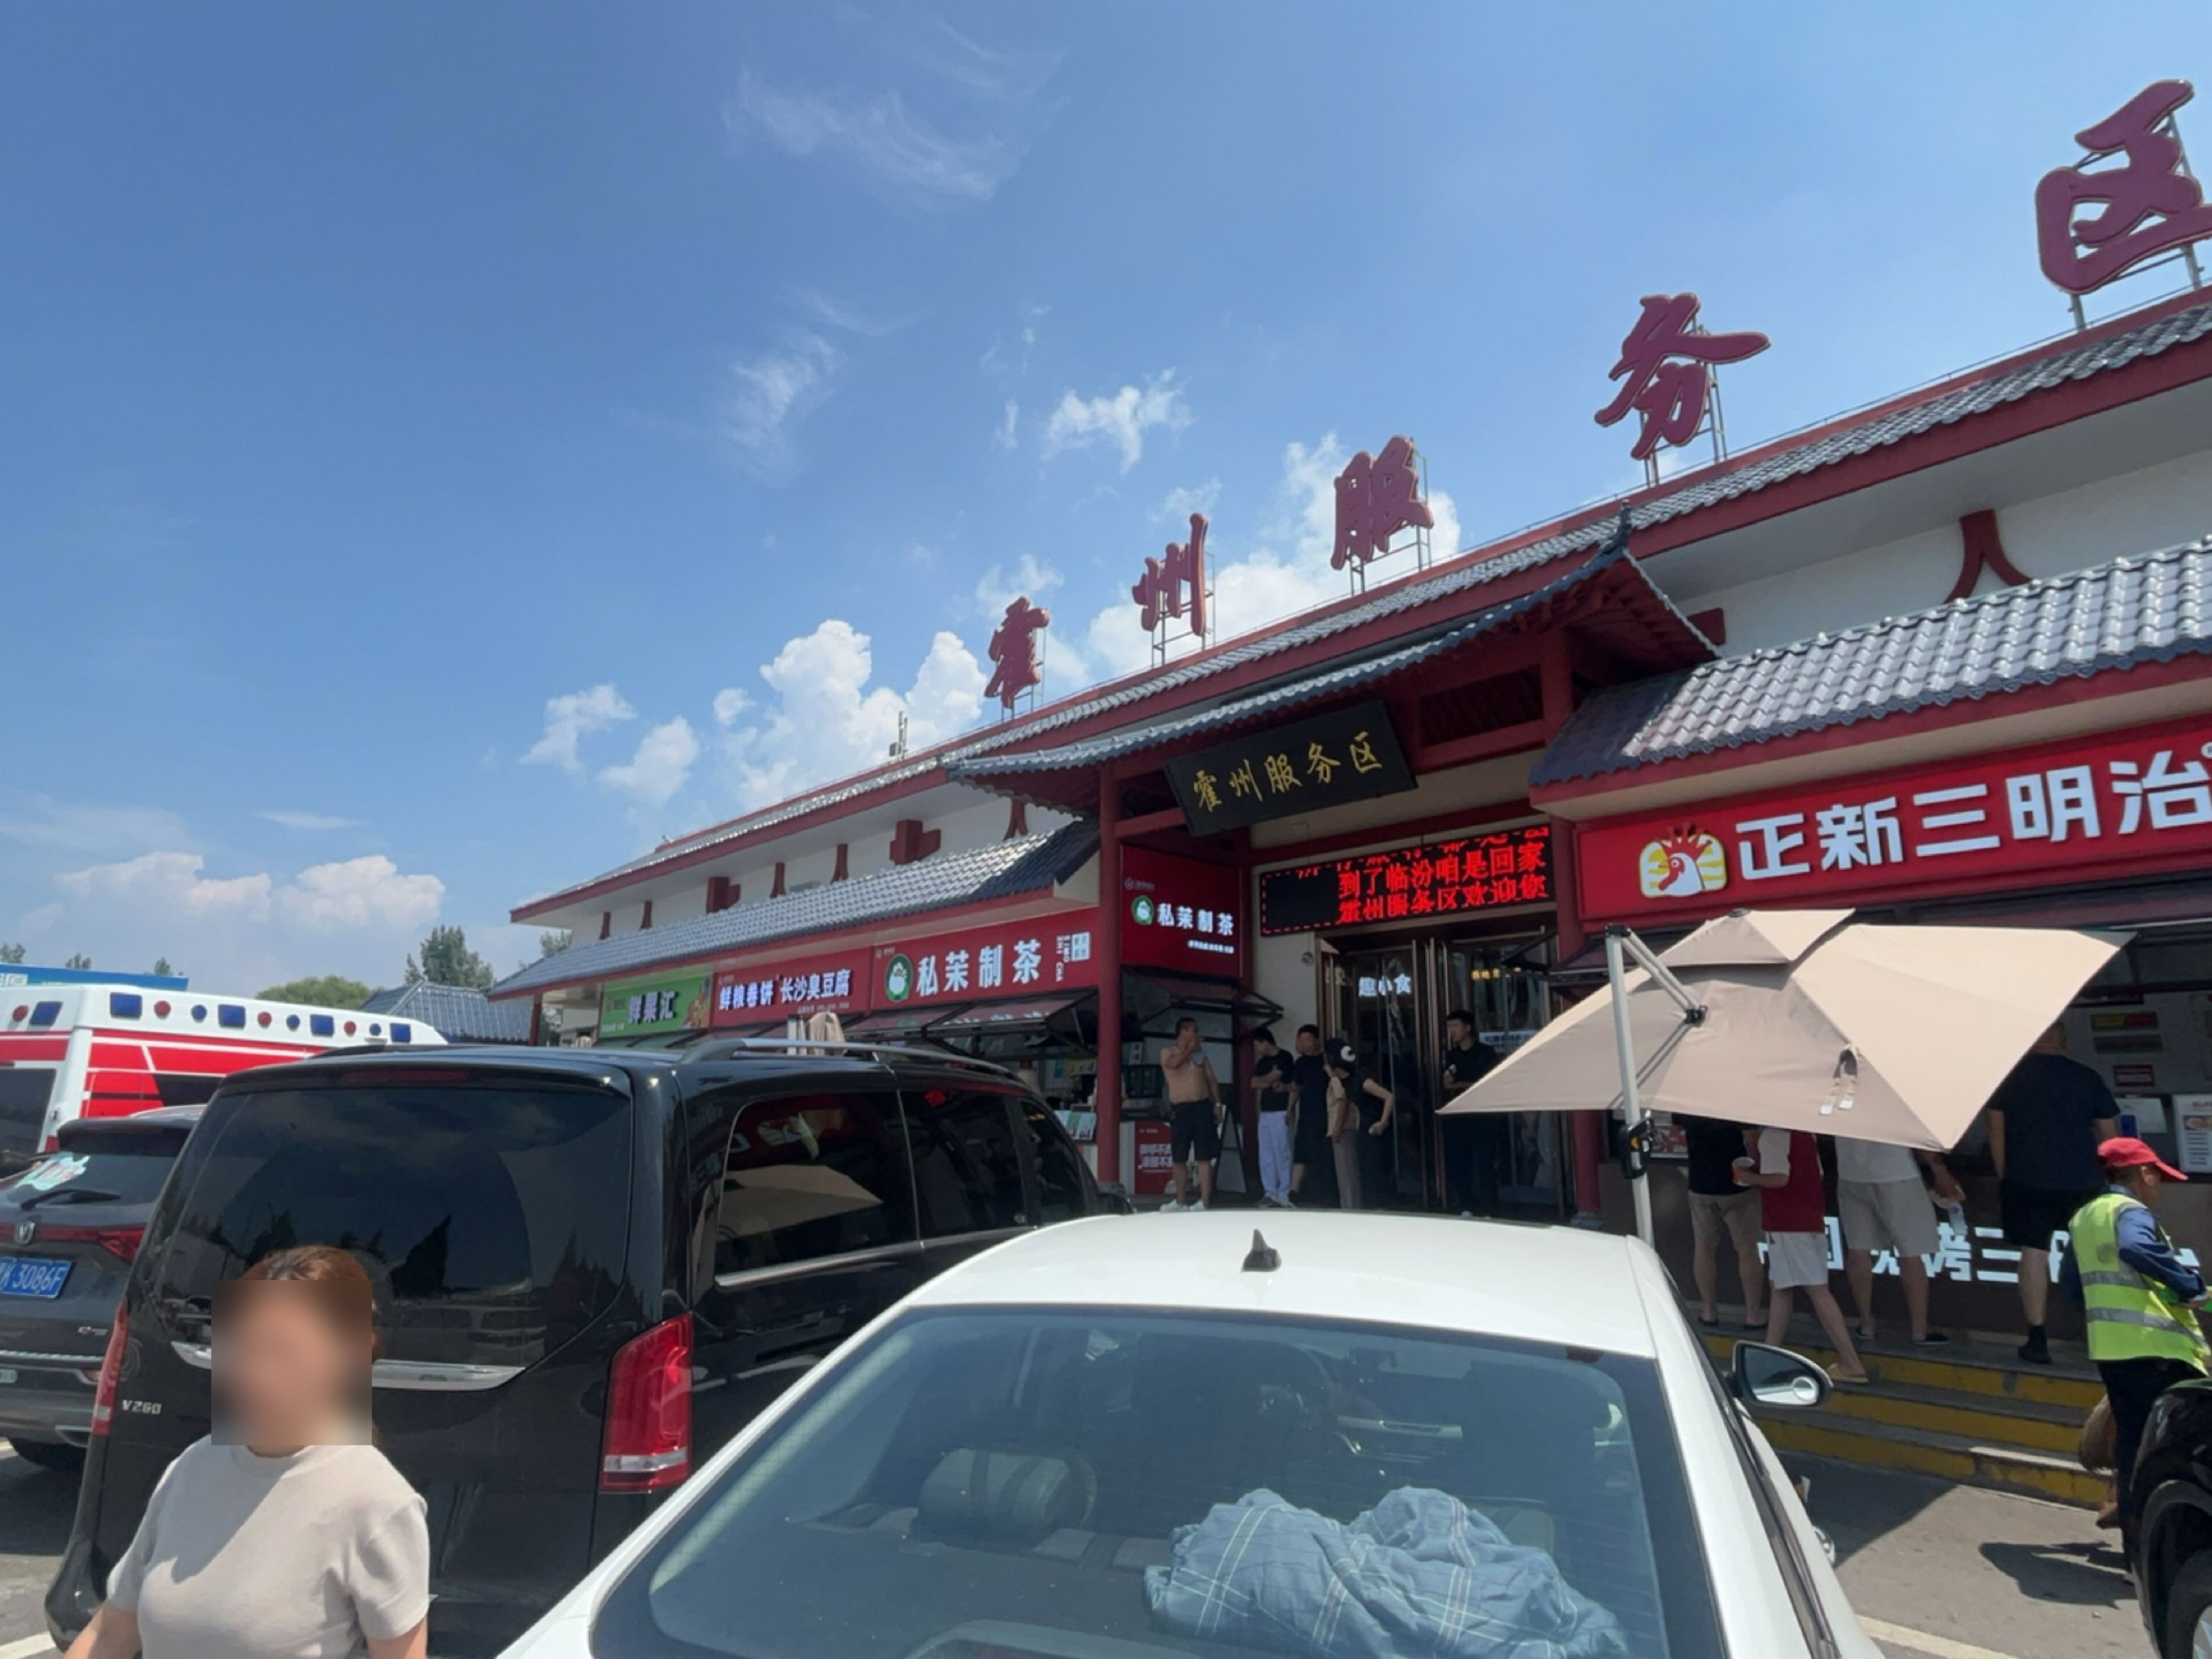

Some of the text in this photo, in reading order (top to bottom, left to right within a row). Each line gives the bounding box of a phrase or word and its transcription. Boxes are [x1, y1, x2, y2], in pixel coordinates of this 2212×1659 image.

[1194, 732, 1382, 812] 霍州服务区
[1735, 750, 2212, 881] 正新三明治
[1340, 842, 1546, 897] 到了临汾咱是回家
[1157, 903, 1235, 936] 私茉制茶
[1337, 874, 1549, 924] 霍州服务区欢迎您
[780, 968, 851, 1003] 长沙臭豆腐
[917, 939, 1042, 997] 私茉制茶
[122, 1399, 162, 1415] V260
